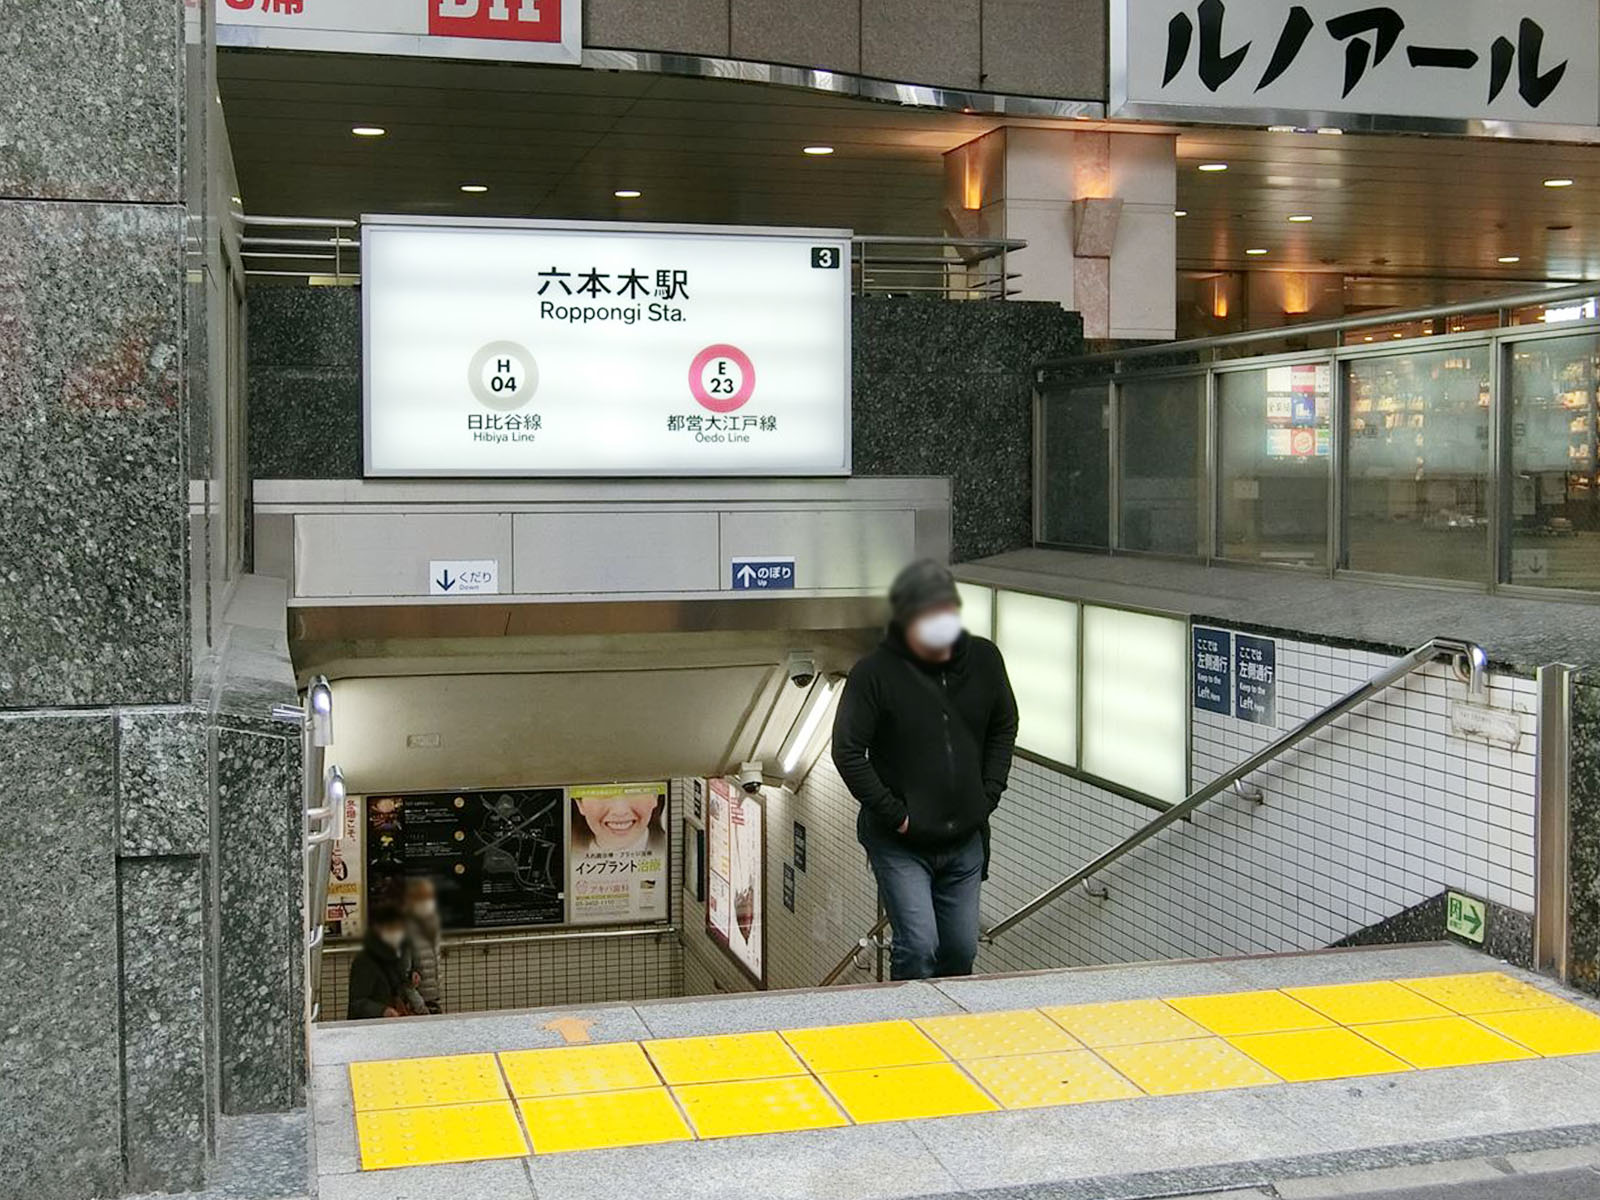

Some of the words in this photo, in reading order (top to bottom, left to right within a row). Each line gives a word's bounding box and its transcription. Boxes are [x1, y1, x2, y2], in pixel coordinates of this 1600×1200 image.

[1161, 0, 1568, 108] ルノアール
[818, 249, 832, 268] 3
[537, 266, 690, 301] 六本木駅
[540, 301, 641, 325] Roppongi
[648, 303, 687, 322] Sta.
[497, 359, 511, 374] H
[718, 361, 727, 376] E
[491, 376, 518, 392] 04
[710, 378, 734, 394] 23
[468, 413, 543, 431] 日比谷線
[667, 414, 778, 432] 都営大江戸線
[473, 431, 509, 445] Hibiya
[511, 431, 536, 442] Line
[728, 432, 750, 443] Line
[459, 571, 493, 584] くだり
[757, 566, 792, 579] のぼり
[757, 579, 768, 588] Up
[1197, 639, 1219, 652] ここでは
[1240, 646, 1264, 661] ここでは
[1197, 651, 1229, 674] 左側通行
[1239, 660, 1274, 684] 左側通行
[1197, 685, 1211, 700] Left
[1240, 696, 1254, 711] Left
[575, 858, 662, 875] インプラント治療
